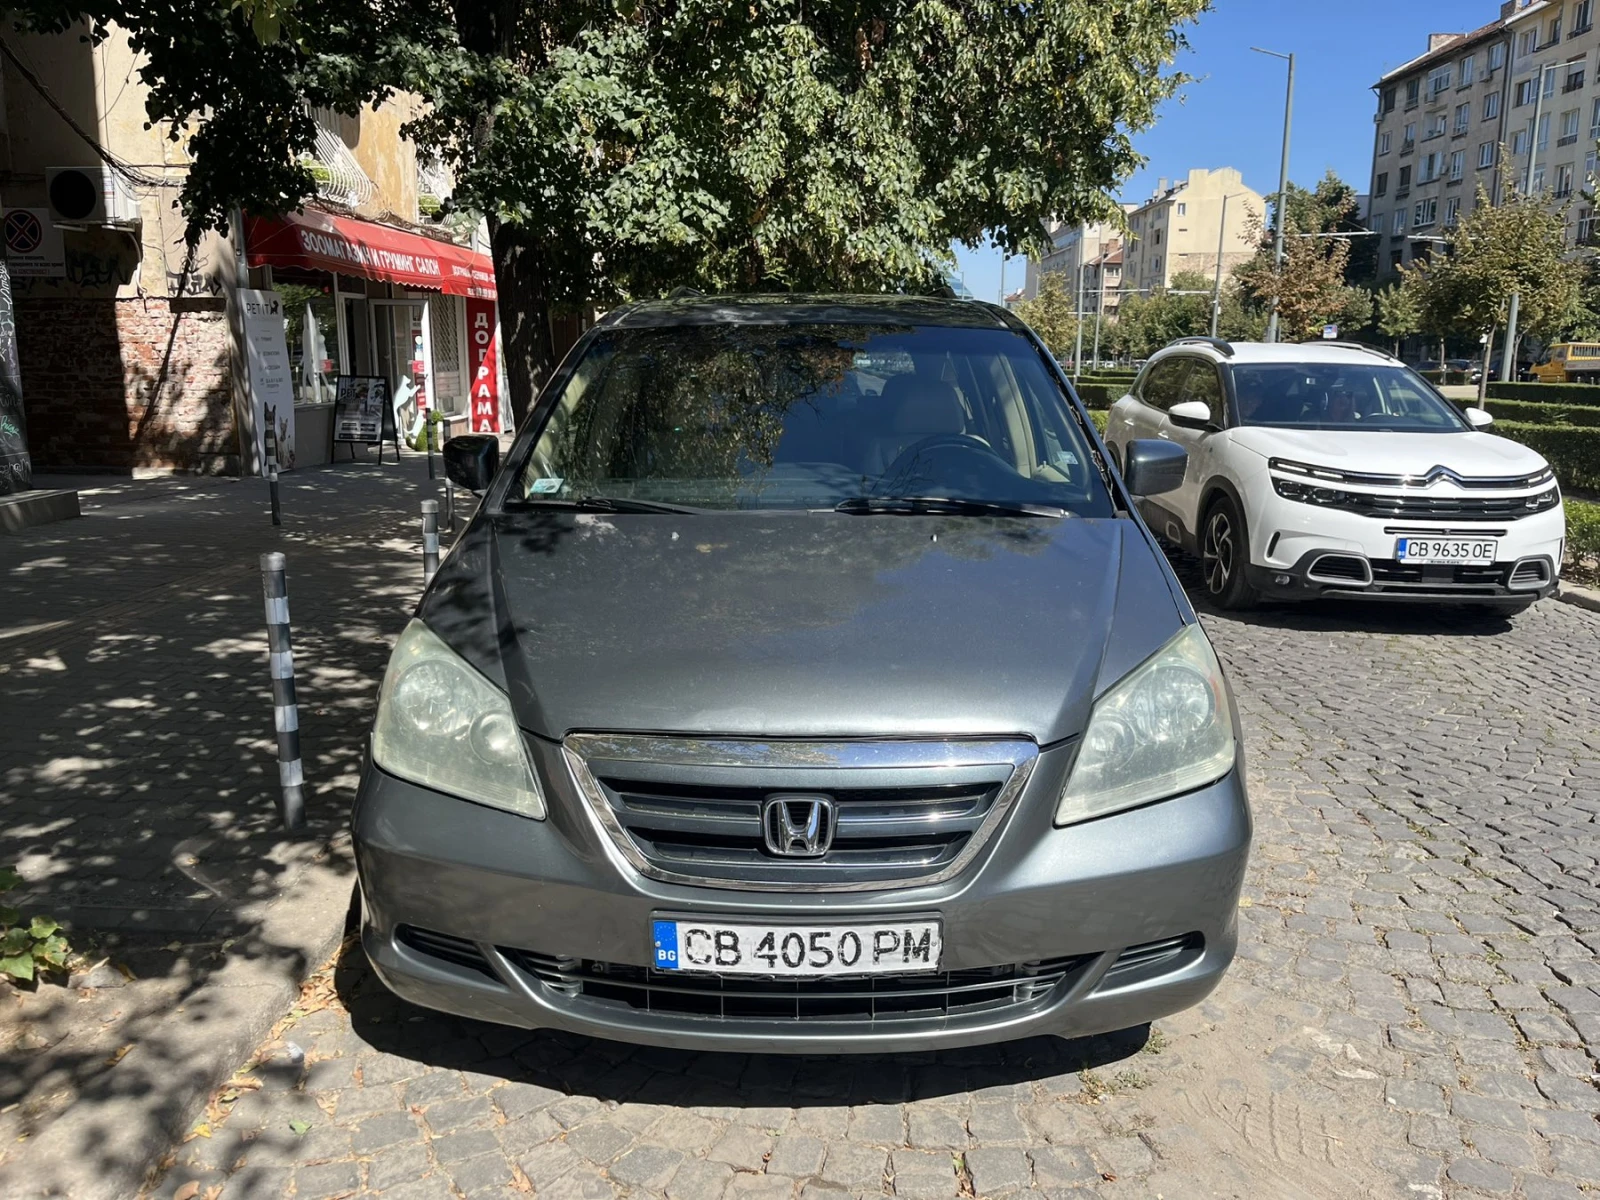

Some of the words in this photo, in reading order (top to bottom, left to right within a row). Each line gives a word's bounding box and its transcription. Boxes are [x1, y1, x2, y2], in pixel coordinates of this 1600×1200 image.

[301, 230, 372, 265] ЗООМАГАЗИН
[380, 250, 415, 272] ГРУМИНГ
[415, 256, 441, 275] САЛОН
[475, 312, 493, 432] ДОГРАМА
[1408, 541, 1429, 557] CB
[1432, 542, 1470, 558] 9635
[1472, 543, 1493, 559] OE
[658, 950, 676, 961] BG
[685, 928, 742, 966] CB
[754, 930, 862, 968] 4050
[872, 928, 931, 965] PM
